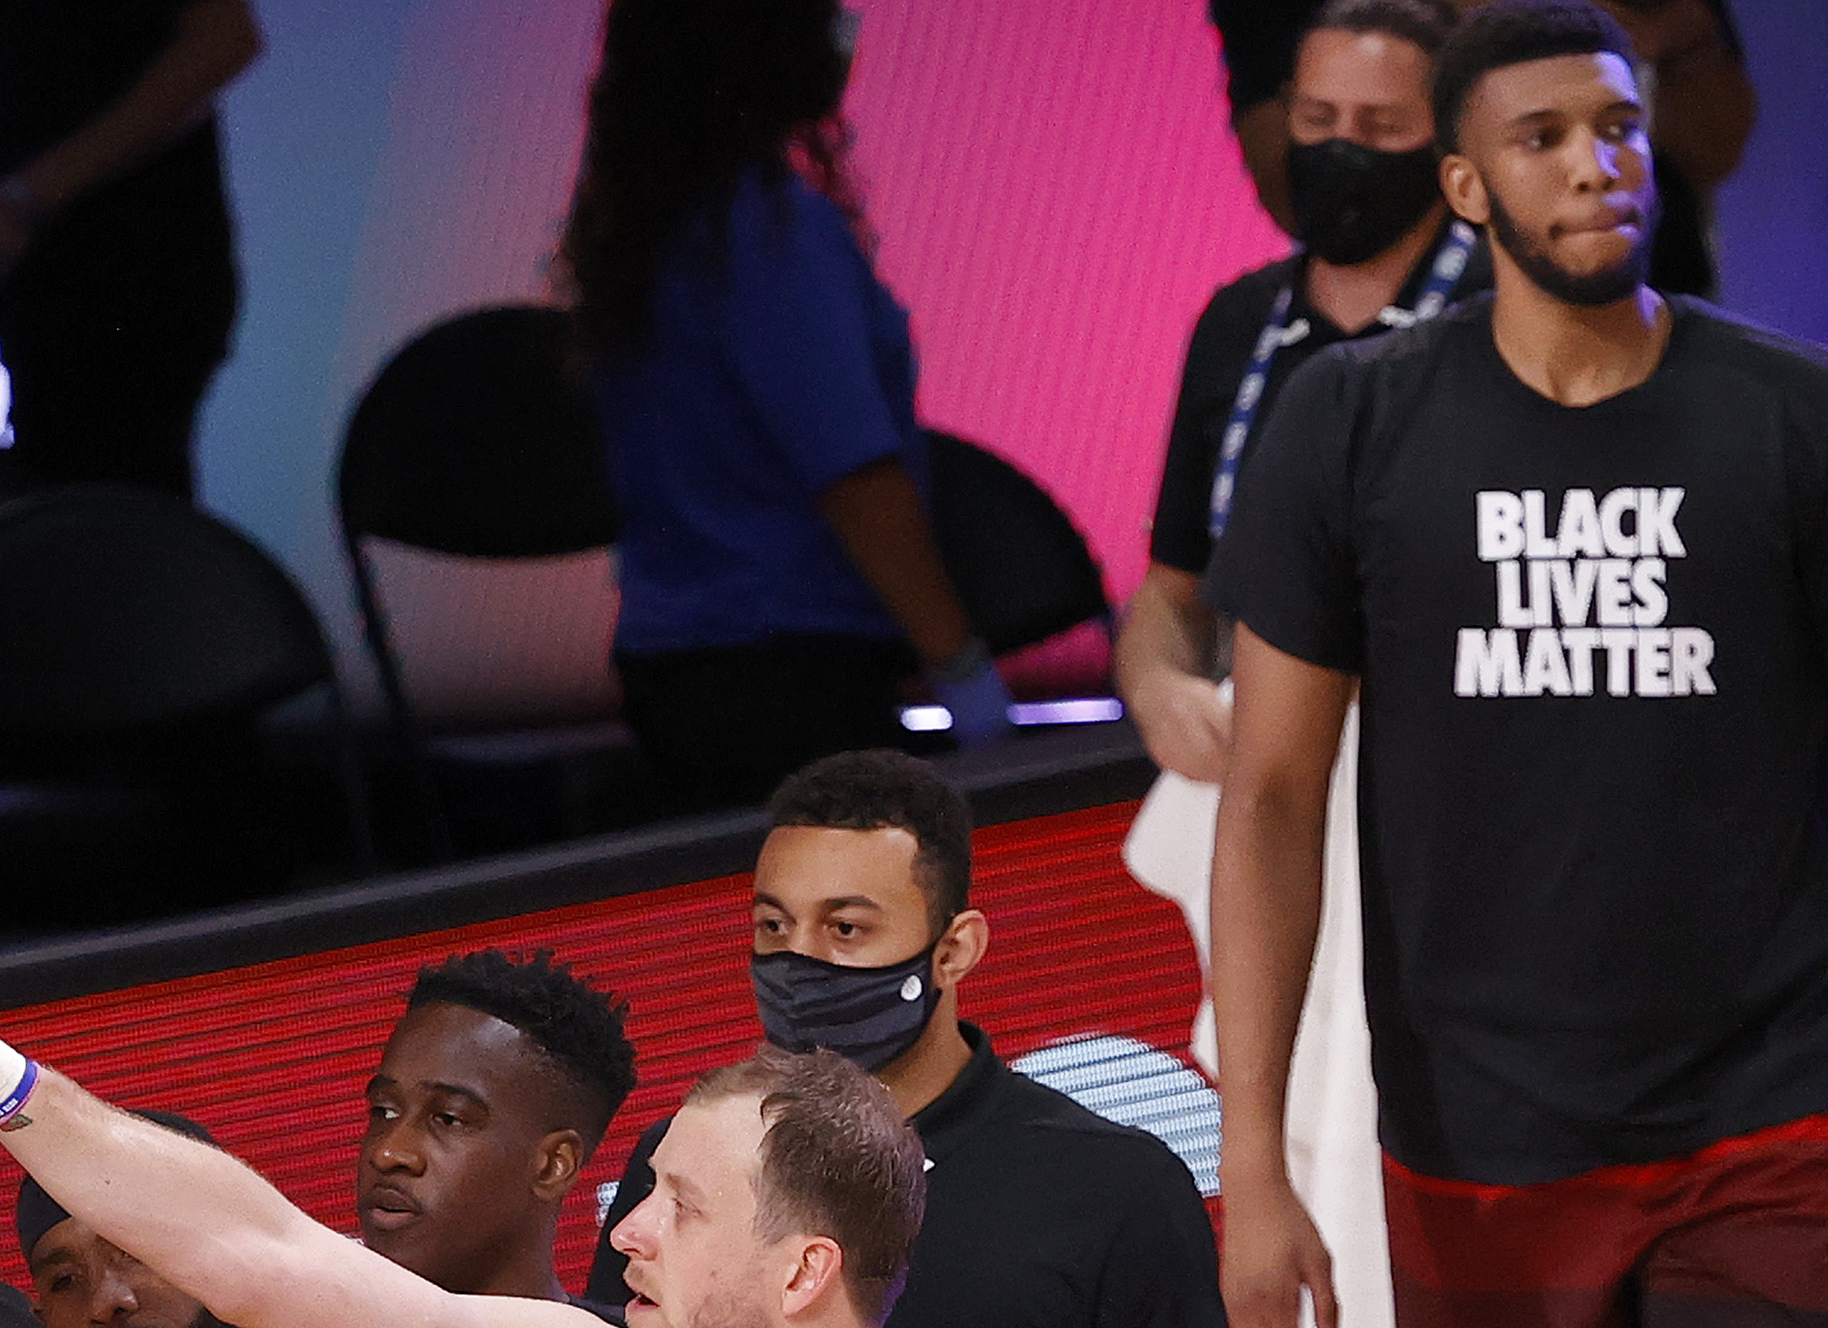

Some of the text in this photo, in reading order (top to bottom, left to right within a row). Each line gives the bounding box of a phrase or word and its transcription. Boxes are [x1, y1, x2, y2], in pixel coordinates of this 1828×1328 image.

[1475, 486, 1688, 561] BLACK
[1495, 559, 1669, 628] LIVES
[1452, 627, 1718, 698] MATTER
